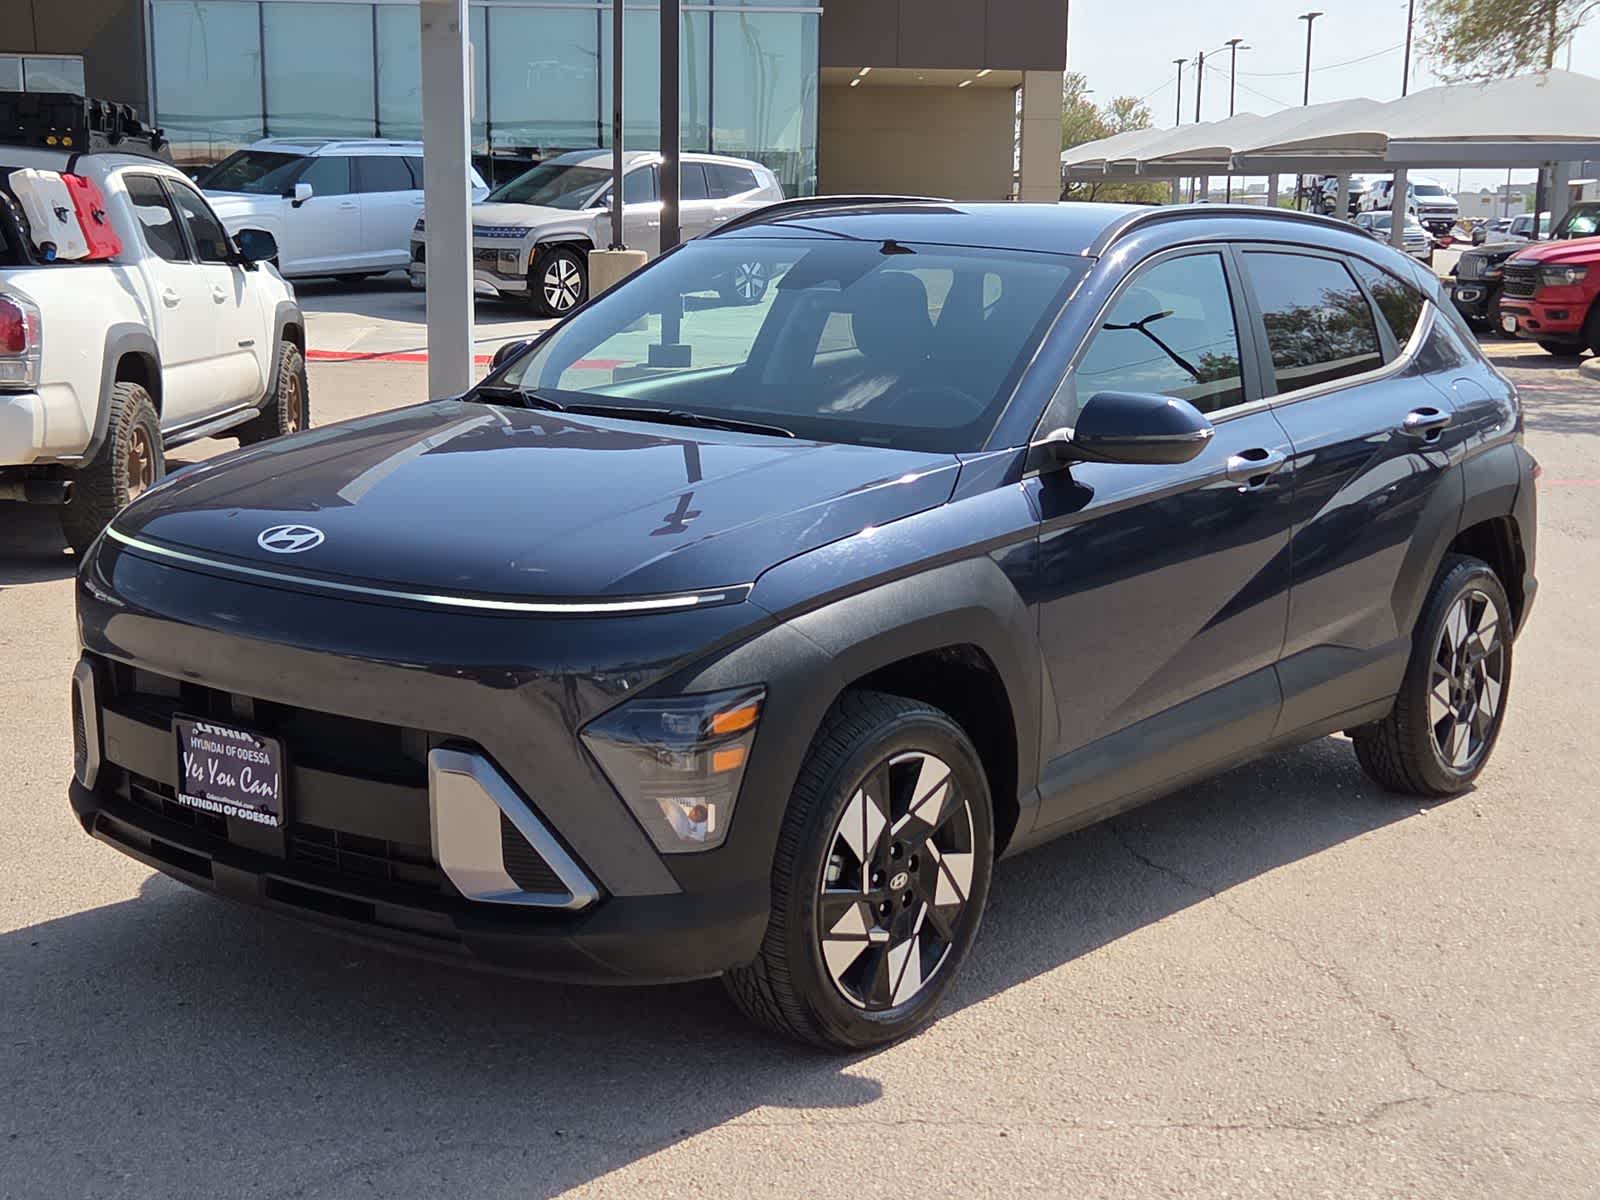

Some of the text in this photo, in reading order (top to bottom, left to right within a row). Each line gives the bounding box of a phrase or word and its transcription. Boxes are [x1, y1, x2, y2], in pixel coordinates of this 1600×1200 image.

[190, 737, 270, 765] HYUNDAI OF ODESSA
[183, 751, 279, 800] Yes You Can!
[178, 793, 278, 827] HYUNDAI OF ODESSA
